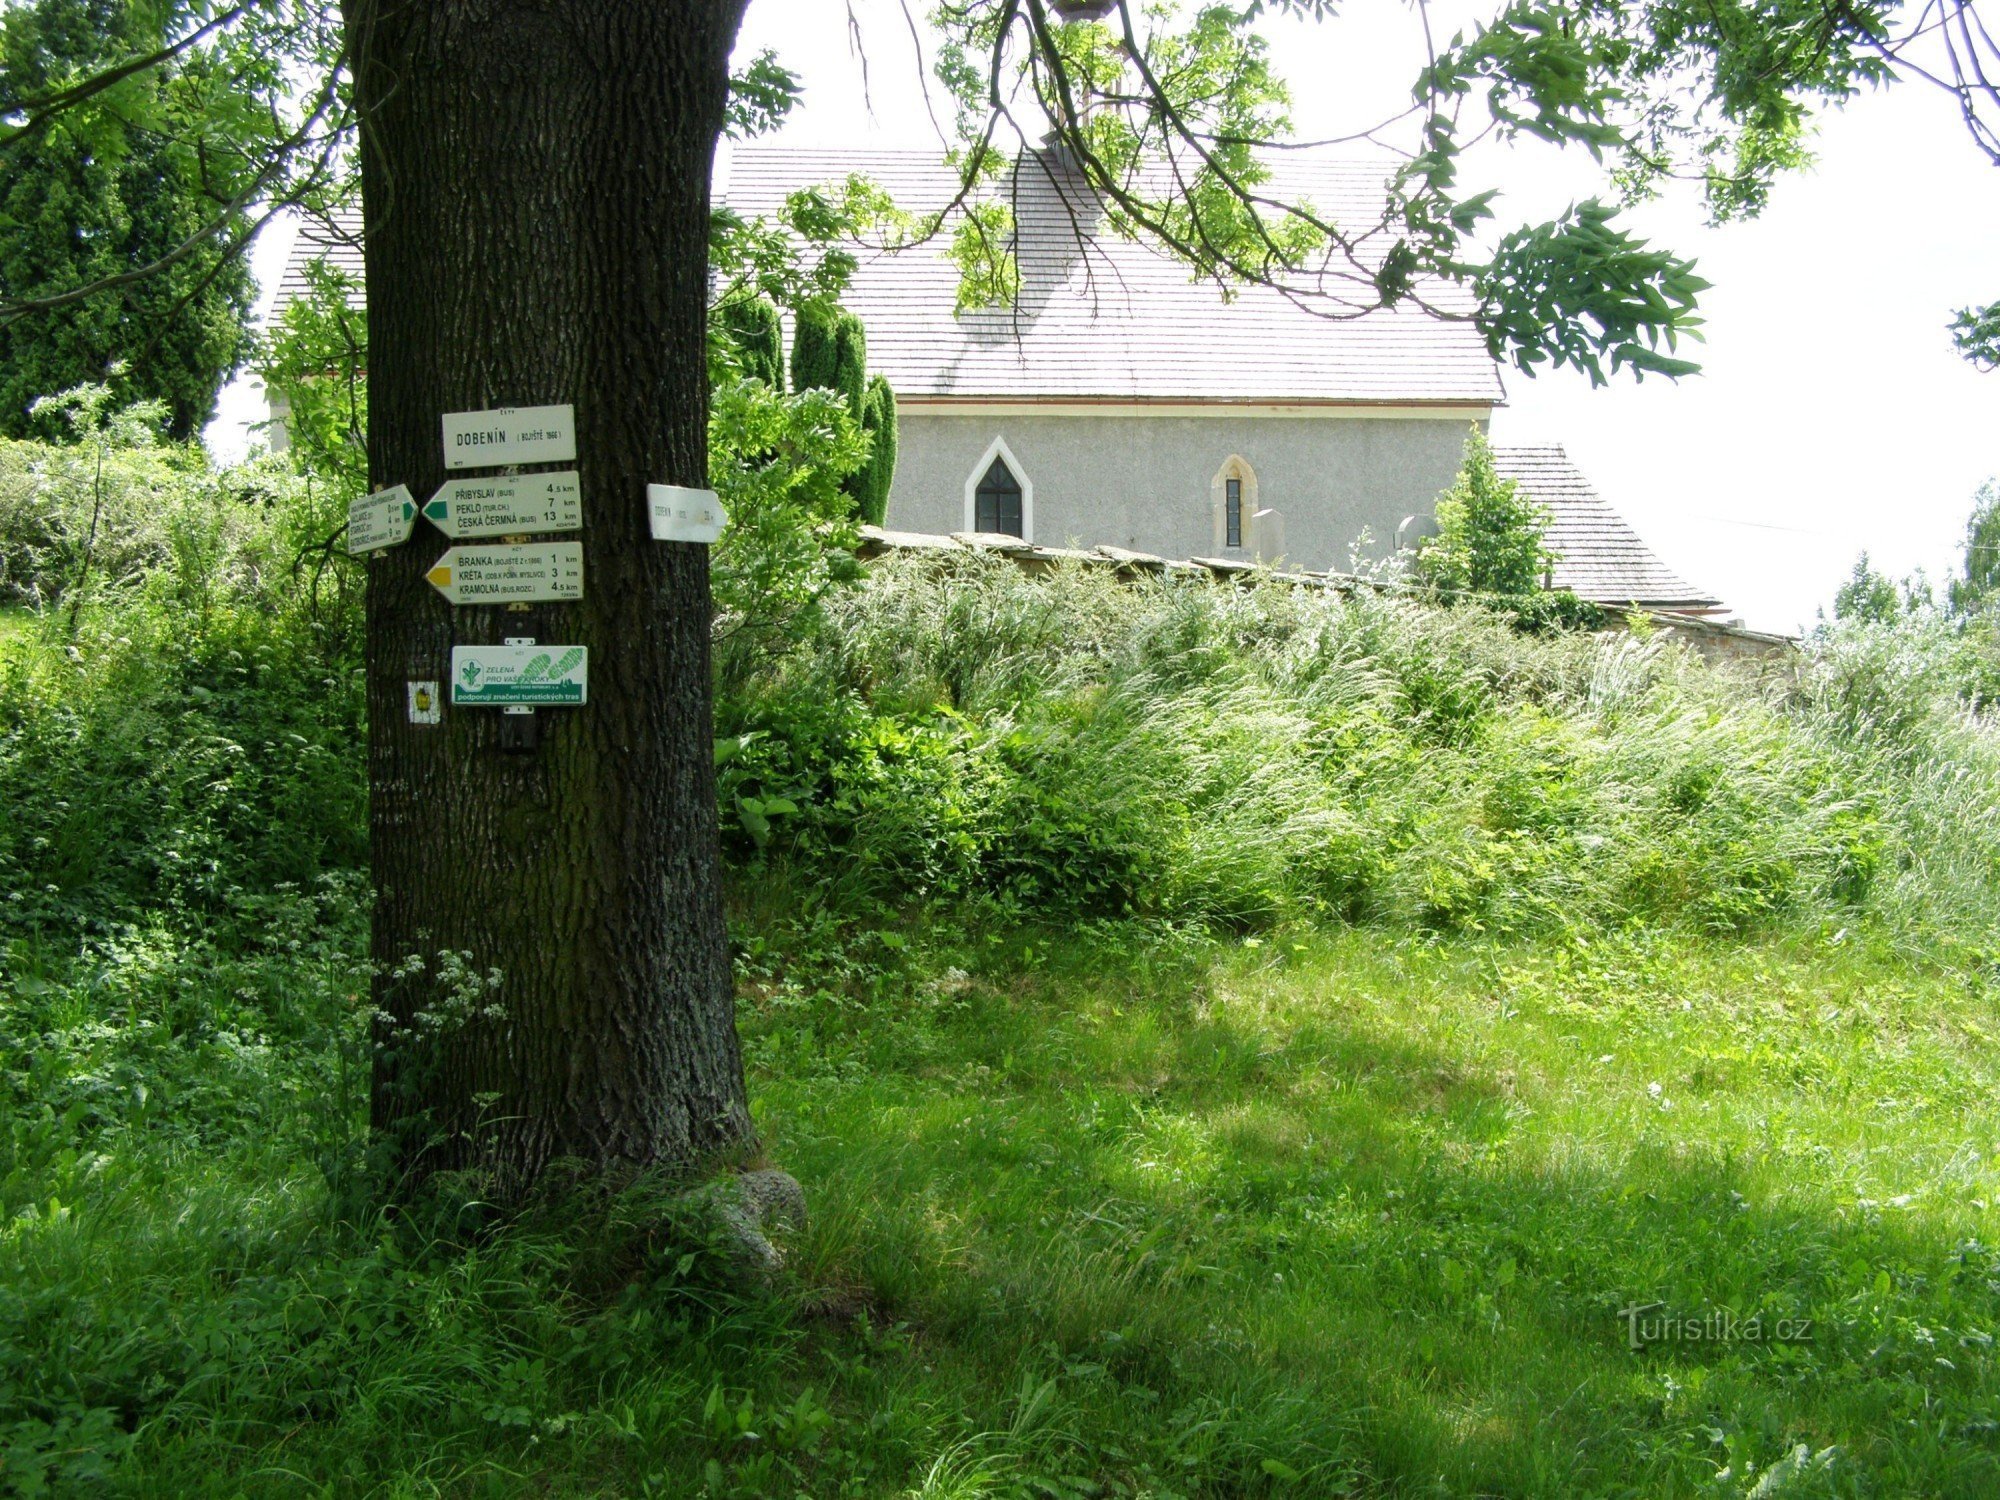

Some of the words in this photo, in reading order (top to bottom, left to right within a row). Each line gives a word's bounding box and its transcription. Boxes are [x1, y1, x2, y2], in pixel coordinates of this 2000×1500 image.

[457, 428, 506, 446] DOBENÍN
[455, 488, 495, 500] PŘIBYSLAV
[497, 489, 514, 497] (BUS)
[456, 503, 481, 514] PEKLO
[548, 498, 555, 507] 7
[458, 516, 483, 528] ČESKÁ
[485, 513, 517, 525] ČERMNÁ
[519, 516, 536, 524] (BUS)
[544, 511, 556, 521] 13
[458, 556, 492, 567] BRANKA
[551, 554, 556, 563] 1
[458, 570, 482, 581] KRÉTA
[552, 568, 558, 577] 3
[460, 584, 499, 595] KRAMOLNA
[458, 693, 491, 701] podporují
[522, 693, 564, 701] turistických
